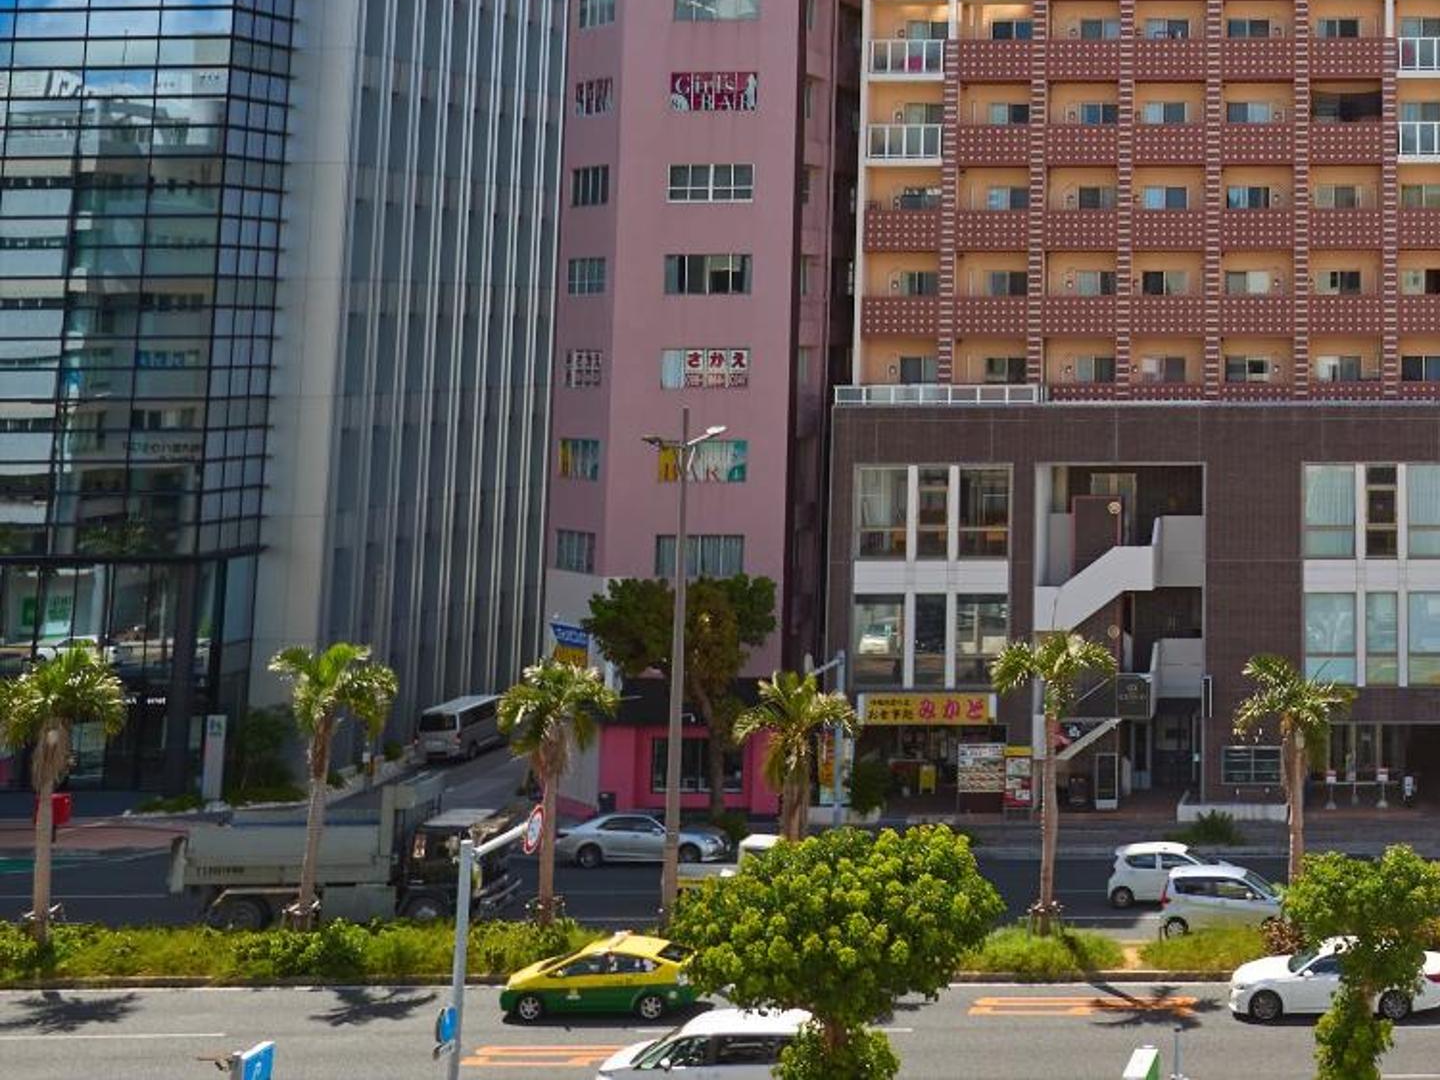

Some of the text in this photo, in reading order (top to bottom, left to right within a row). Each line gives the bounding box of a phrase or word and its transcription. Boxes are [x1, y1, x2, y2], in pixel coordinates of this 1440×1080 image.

[687, 351, 746, 368] さかえ
[919, 697, 984, 720] みかど
